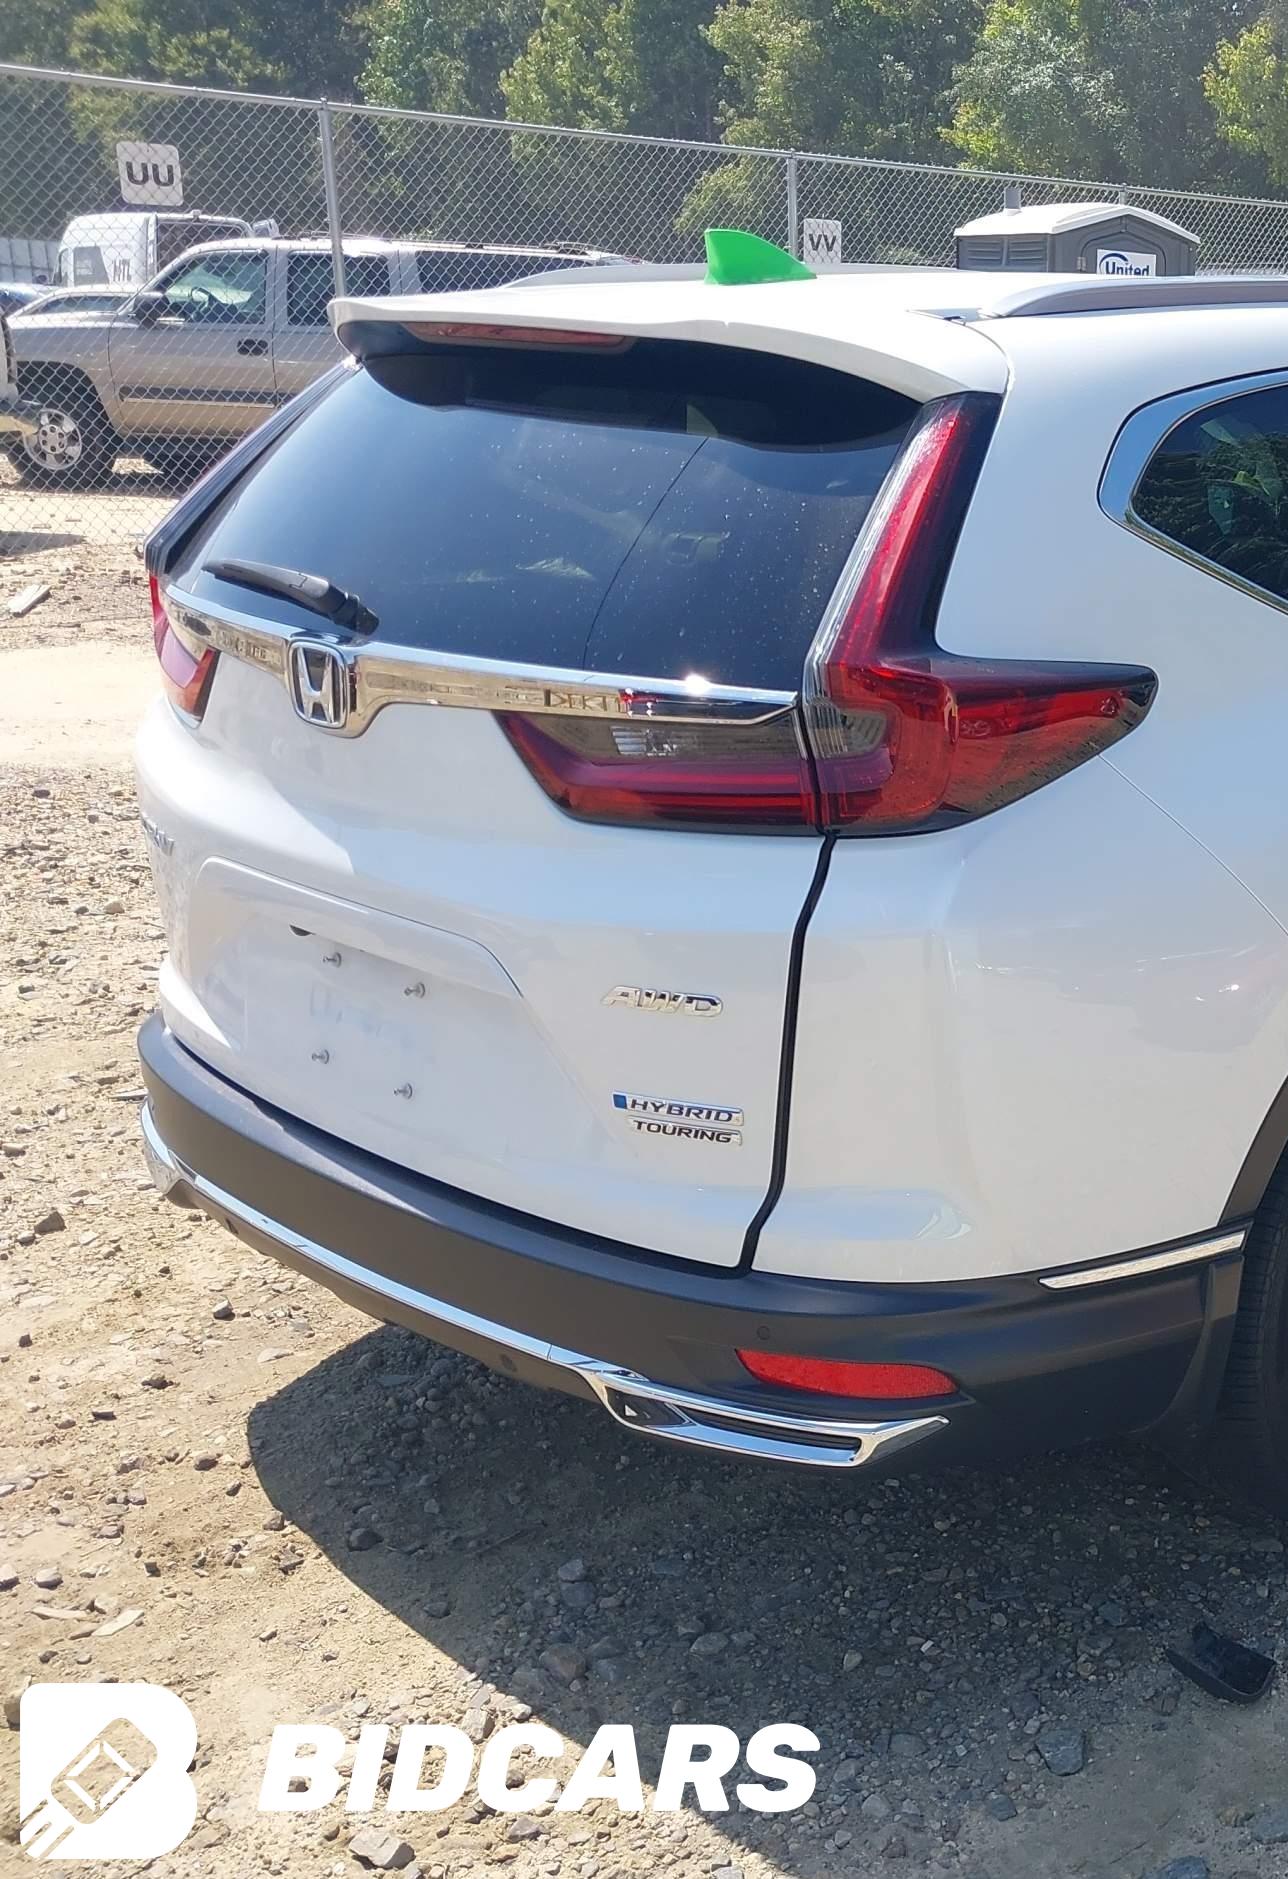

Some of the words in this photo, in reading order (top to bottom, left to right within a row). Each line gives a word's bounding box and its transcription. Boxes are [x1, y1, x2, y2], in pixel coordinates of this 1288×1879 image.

[126, 161, 174, 187] UU
[808, 233, 837, 252] VV
[1105, 260, 1150, 276] United
[600, 984, 724, 1018] AWD
[630, 1098, 733, 1123] HYBRID
[633, 1119, 732, 1144] TOURING
